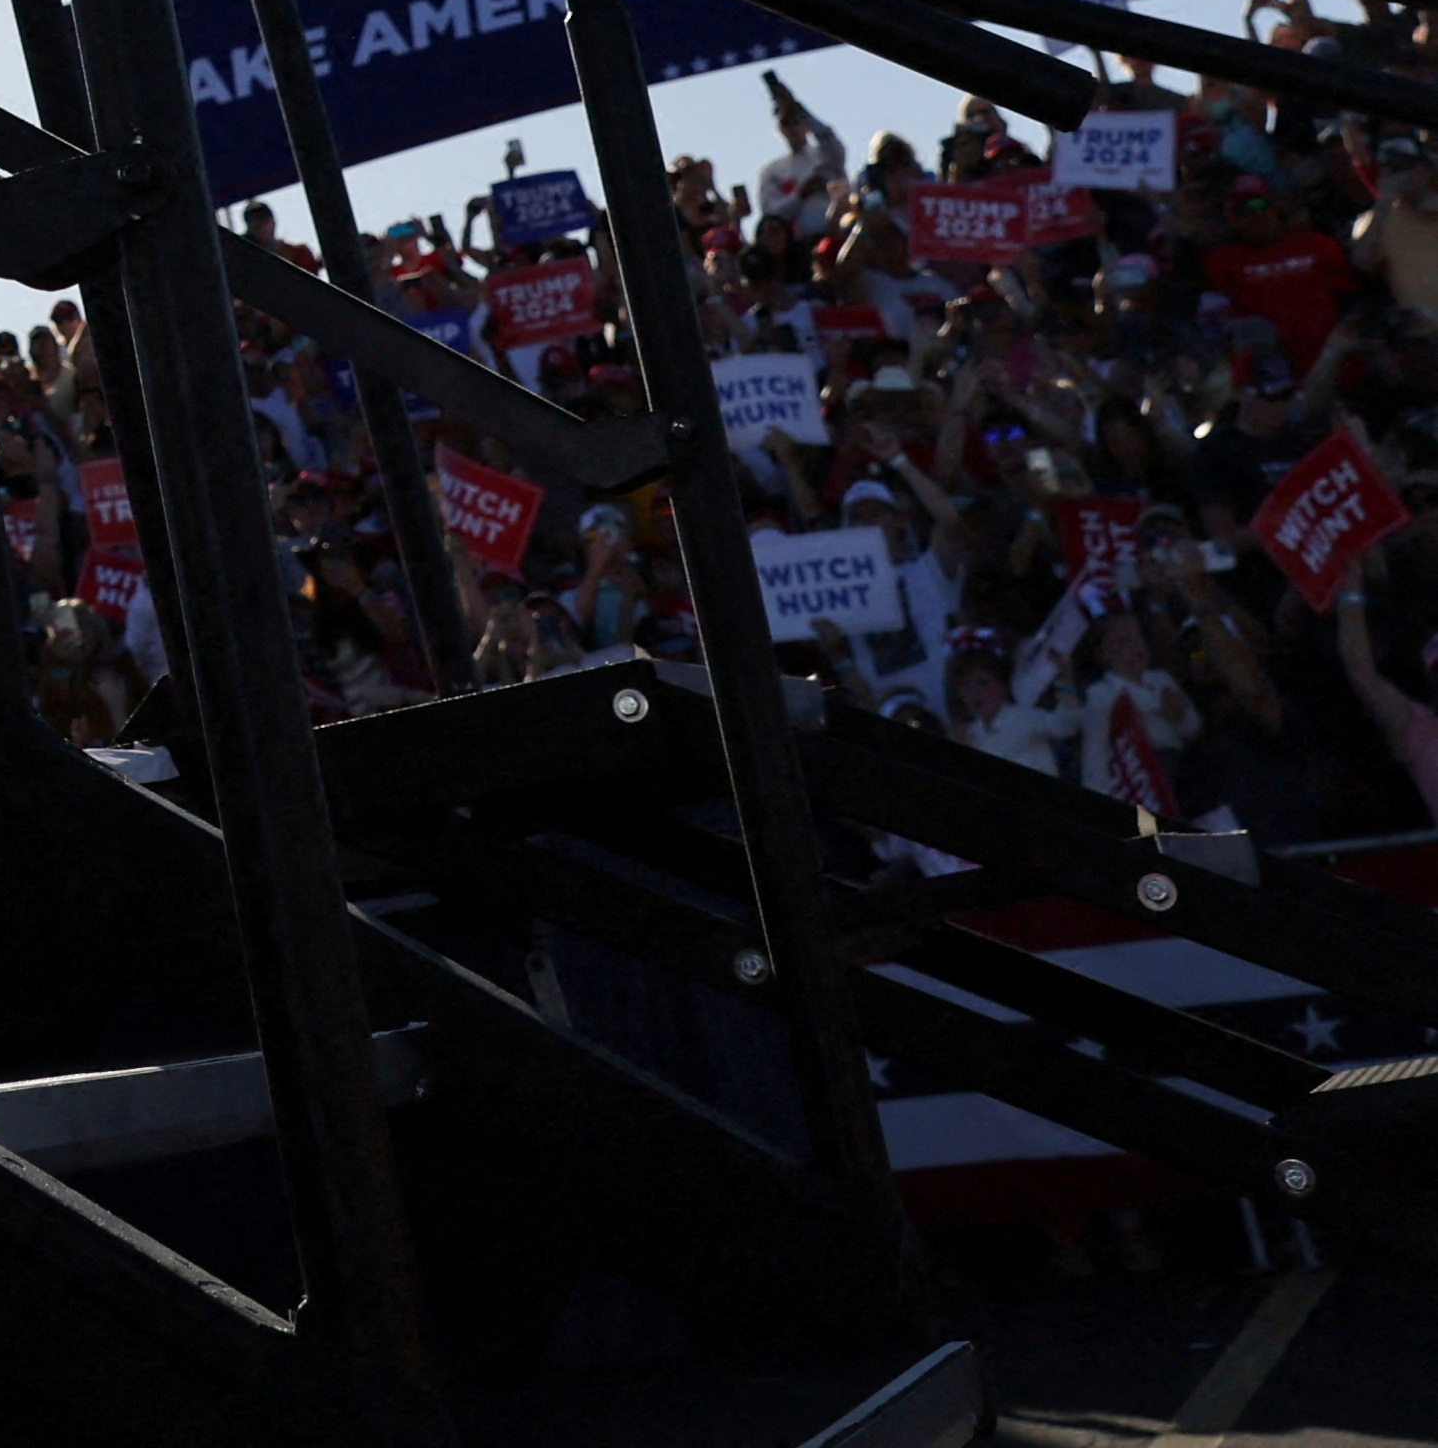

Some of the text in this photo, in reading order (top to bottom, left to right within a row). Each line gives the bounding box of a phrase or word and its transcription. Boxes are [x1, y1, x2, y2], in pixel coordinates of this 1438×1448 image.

[1081, 147, 1151, 165] 2024
[500, 180, 575, 210] TRUMP
[919, 195, 1021, 221] TRUMP
[934, 213, 1007, 240] 2024
[494, 272, 582, 307] TRUMP
[511, 294, 574, 324] 2024
[725, 401, 802, 429] HUNT
[1275, 459, 1360, 552] WITCH
[1300, 491, 1368, 575] HUNT
[759, 555, 875, 588] WITCH
[775, 584, 871, 617] HUNT
